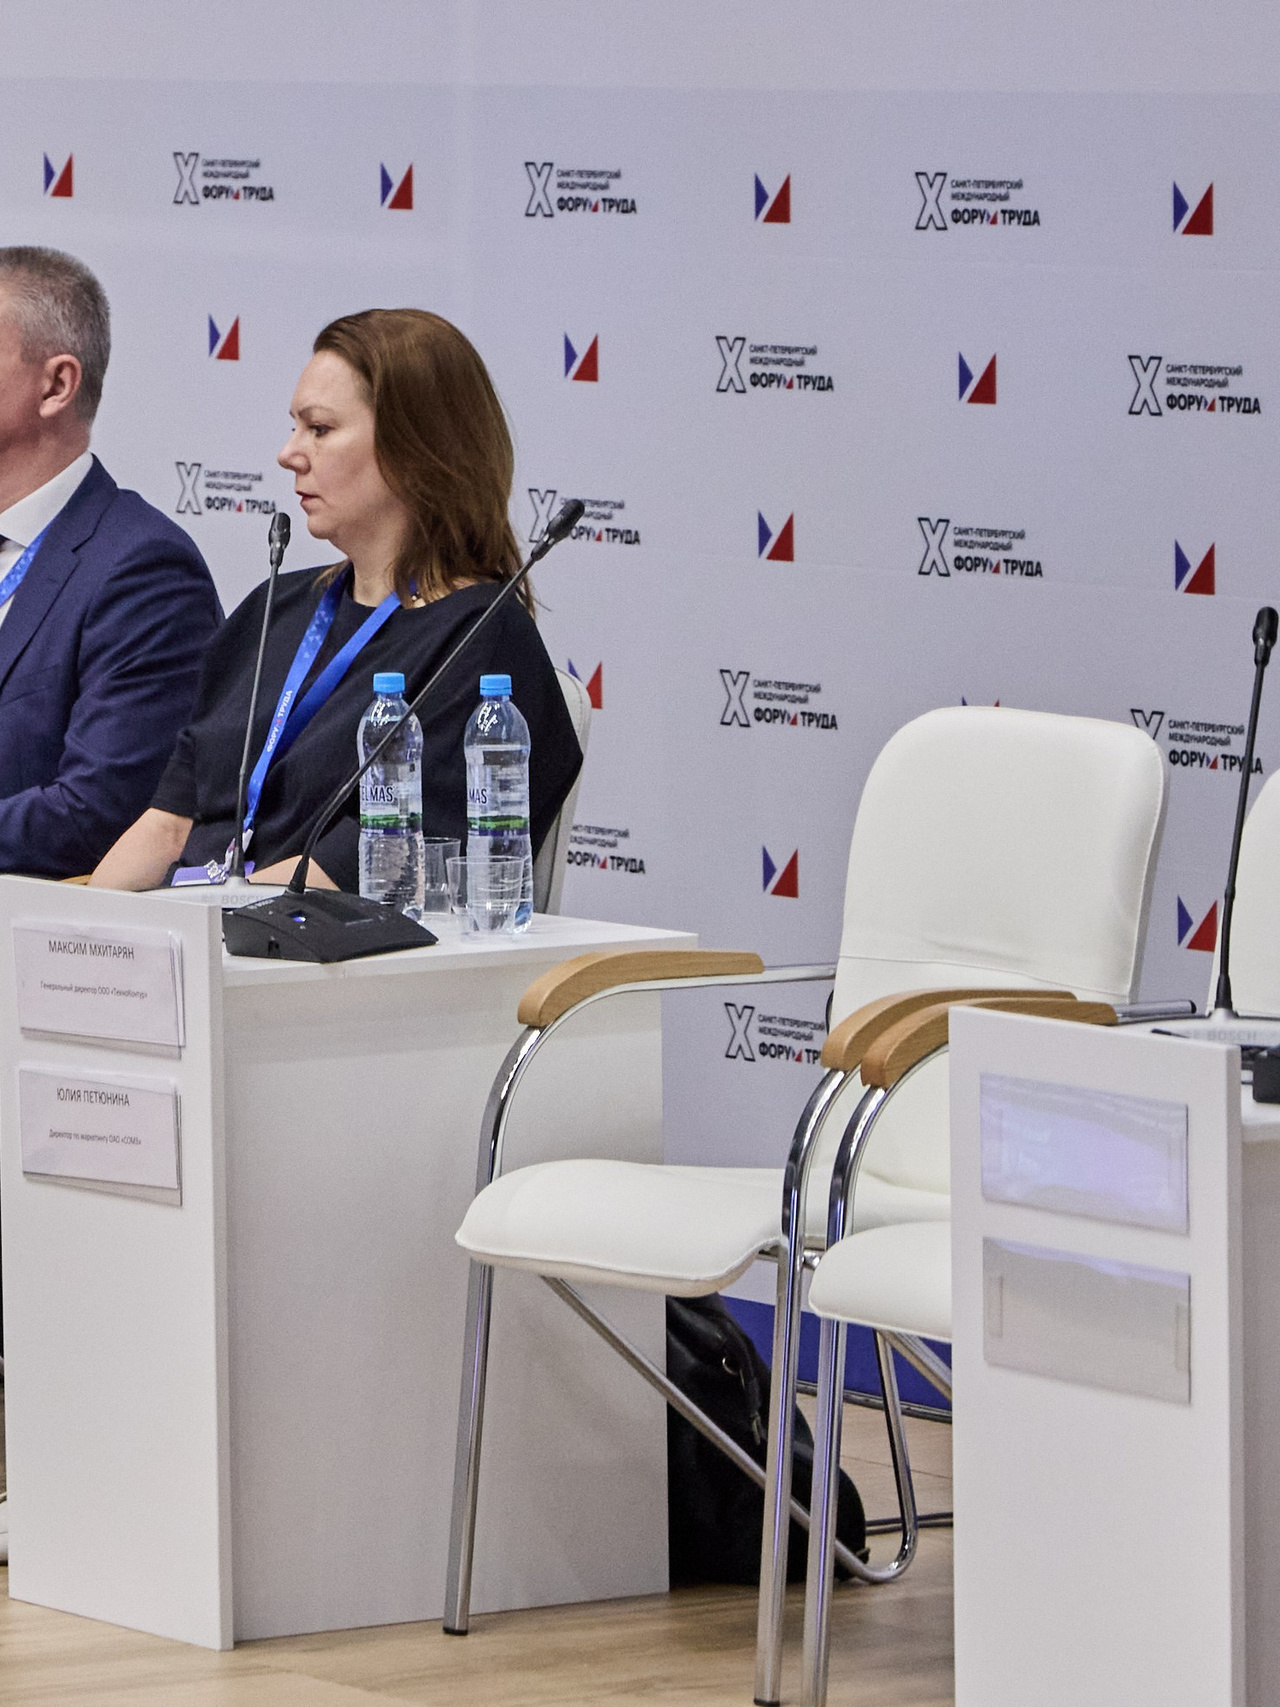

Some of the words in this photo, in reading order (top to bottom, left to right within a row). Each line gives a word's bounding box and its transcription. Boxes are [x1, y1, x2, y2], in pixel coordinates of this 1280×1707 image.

[601, 198, 637, 214] ТРУДА
[1001, 209, 1040, 226] ТРУДА
[1166, 364, 1243, 376] САНКТ-ПЕТЕРБУРГСКИЙ
[796, 374, 834, 392] ТРУДА
[1166, 377, 1229, 388] МЕЖДУНАРОДНЫЙ
[1219, 396, 1261, 414] ТРУДА
[605, 528, 641, 545] ТРУДА
[954, 527, 1026, 540] САНКТ-ПЕТЕРБУРГСКИЙ
[1003, 559, 1043, 577] ТРУДА
[278, 690, 293, 717] ТРУДА
[800, 711, 838, 730] ТРУДА
[1168, 719, 1245, 735] САНКТ-ПЕТЕРБУРГСКИЙ
[1168, 732, 1231, 747] МЕЖДУНАРОДНЫЙ
[609, 855, 646, 874] ТРУДА
[48, 940, 88, 955] МАКСИМ
[89, 943, 135, 960] МХИТАРЯН
[57, 1088, 81, 1102] ЮЛИЯ
[83, 1090, 130, 1106] ПЕТЮНИНА
